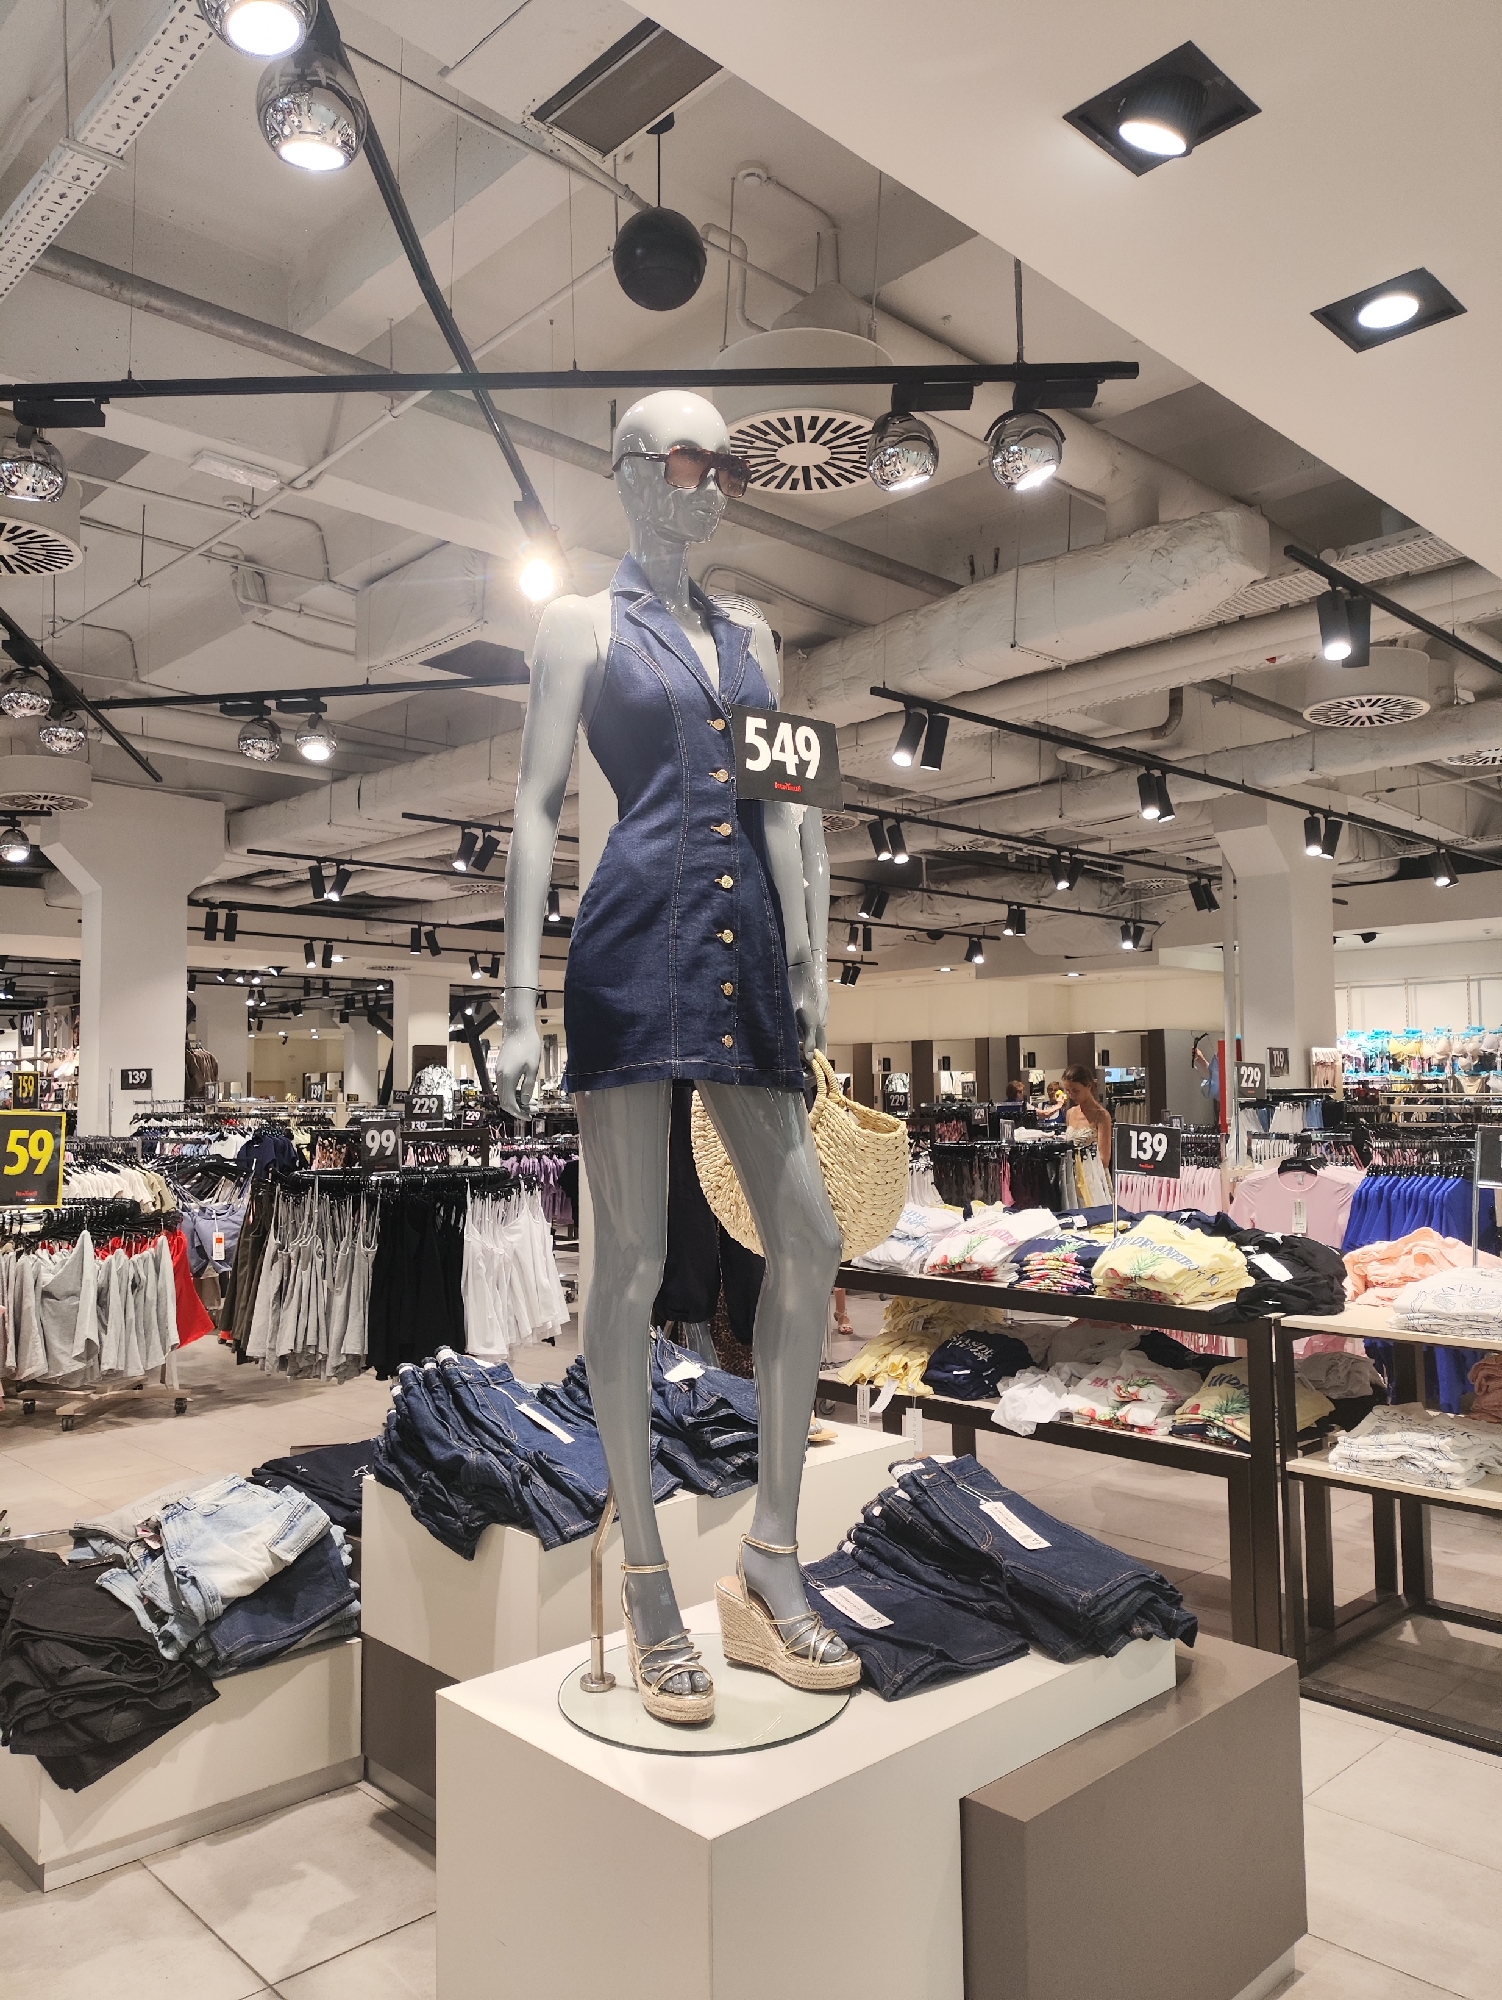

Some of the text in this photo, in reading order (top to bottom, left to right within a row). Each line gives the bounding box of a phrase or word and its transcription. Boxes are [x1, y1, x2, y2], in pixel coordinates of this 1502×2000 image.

[745, 716, 821, 780] 549
[1272, 1051, 1285, 1067] 119
[128, 1070, 147, 1084] 139
[1240, 1066, 1261, 1088] 229
[18, 1075, 35, 1098] 159
[310, 1084, 322, 1098] 139
[412, 1097, 438, 1114] 229
[889, 1094, 906, 1106] 229
[466, 1111, 480, 1121] 229
[974, 1108, 985, 1119] 229
[365, 1129, 396, 1157] 99
[1129, 1130, 1168, 1161] 139
[4, 1129, 55, 1175] 59
